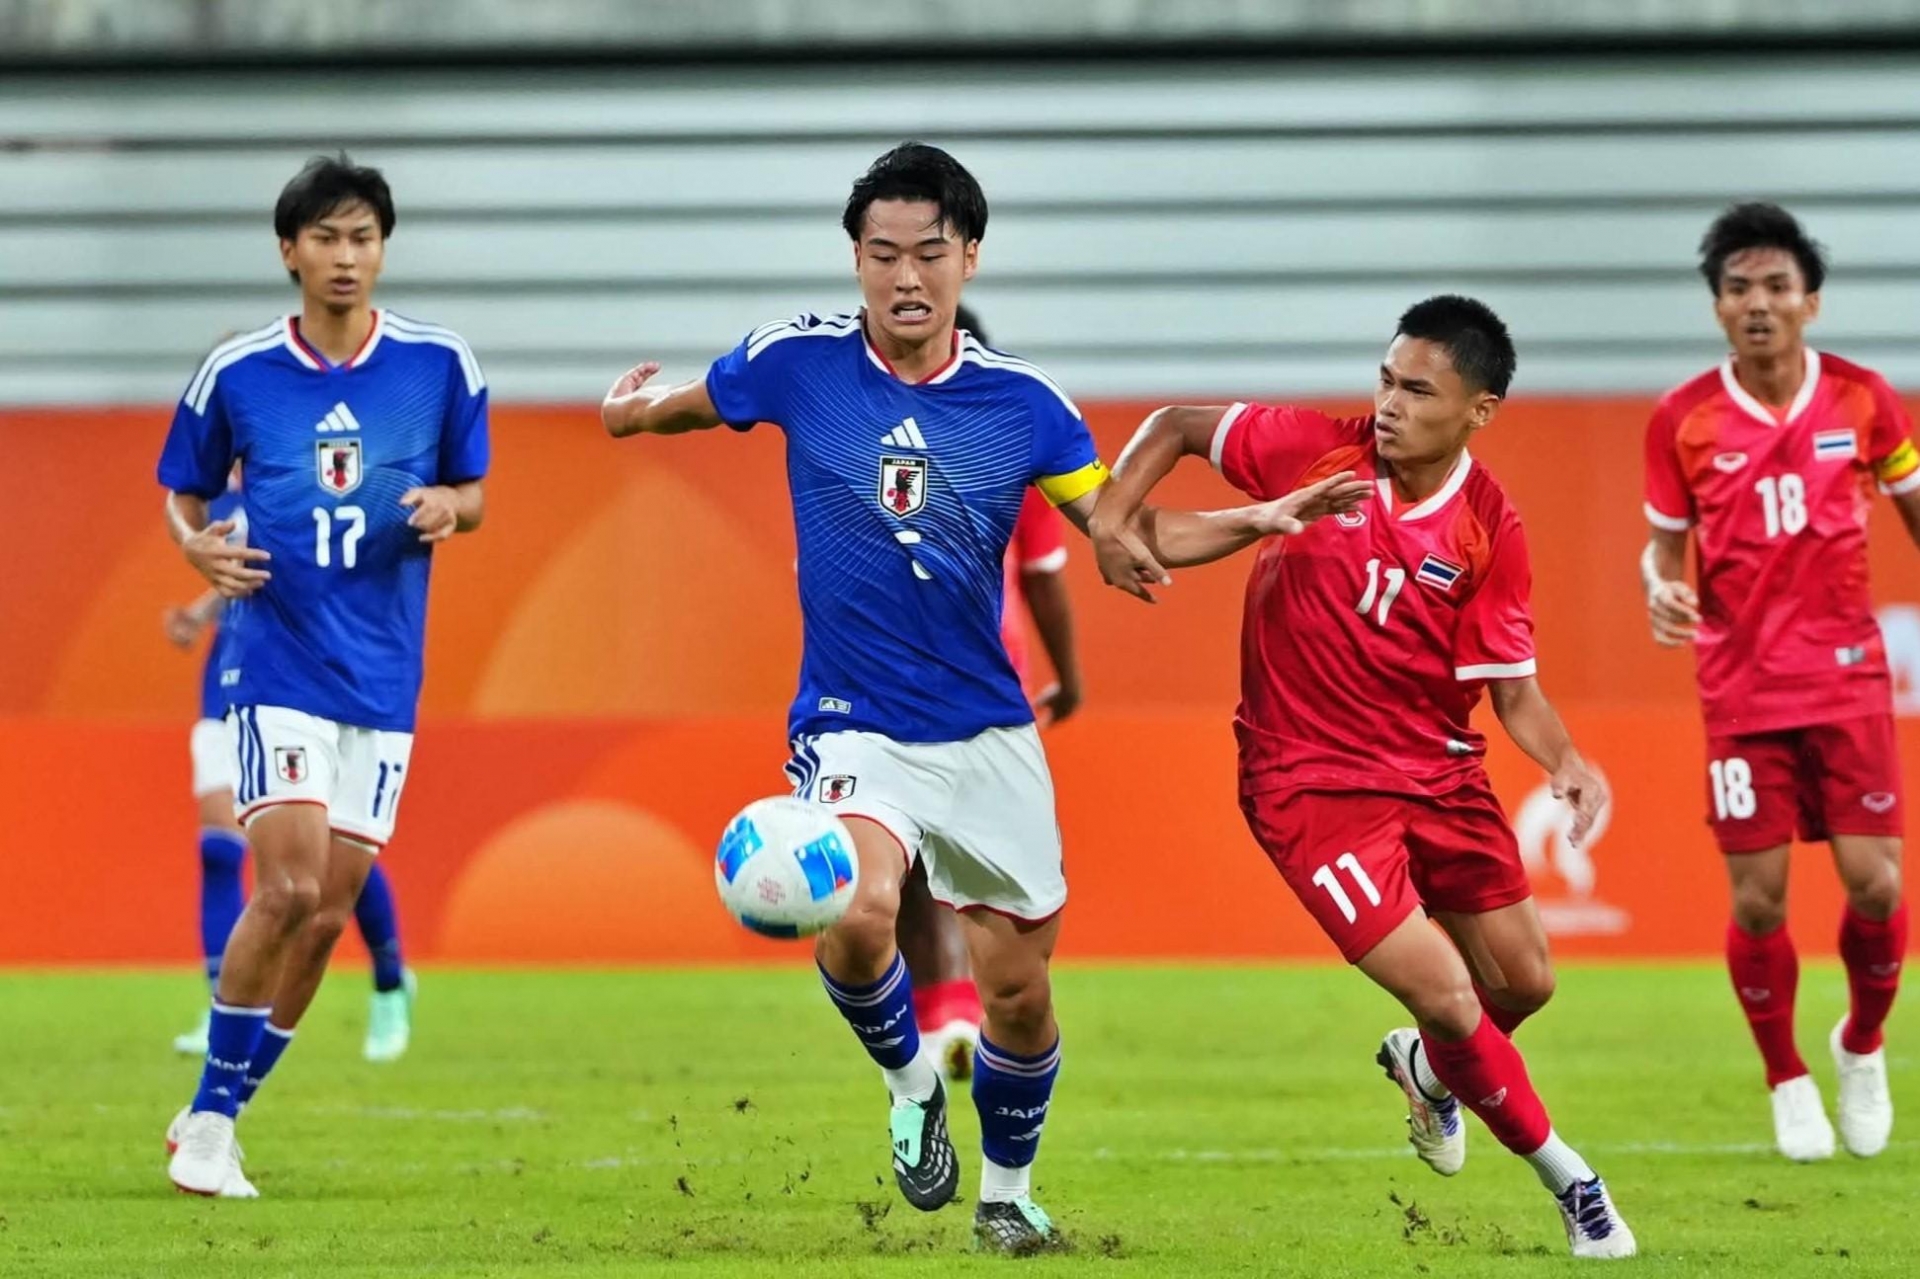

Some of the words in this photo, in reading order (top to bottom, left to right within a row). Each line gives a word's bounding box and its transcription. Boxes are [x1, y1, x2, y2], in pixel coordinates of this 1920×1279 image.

[312, 505, 367, 568] 17
[1755, 473, 1808, 538] 18
[1355, 557, 1406, 626] 11
[1709, 757, 1757, 820] 18
[1311, 851, 1382, 925] 11
